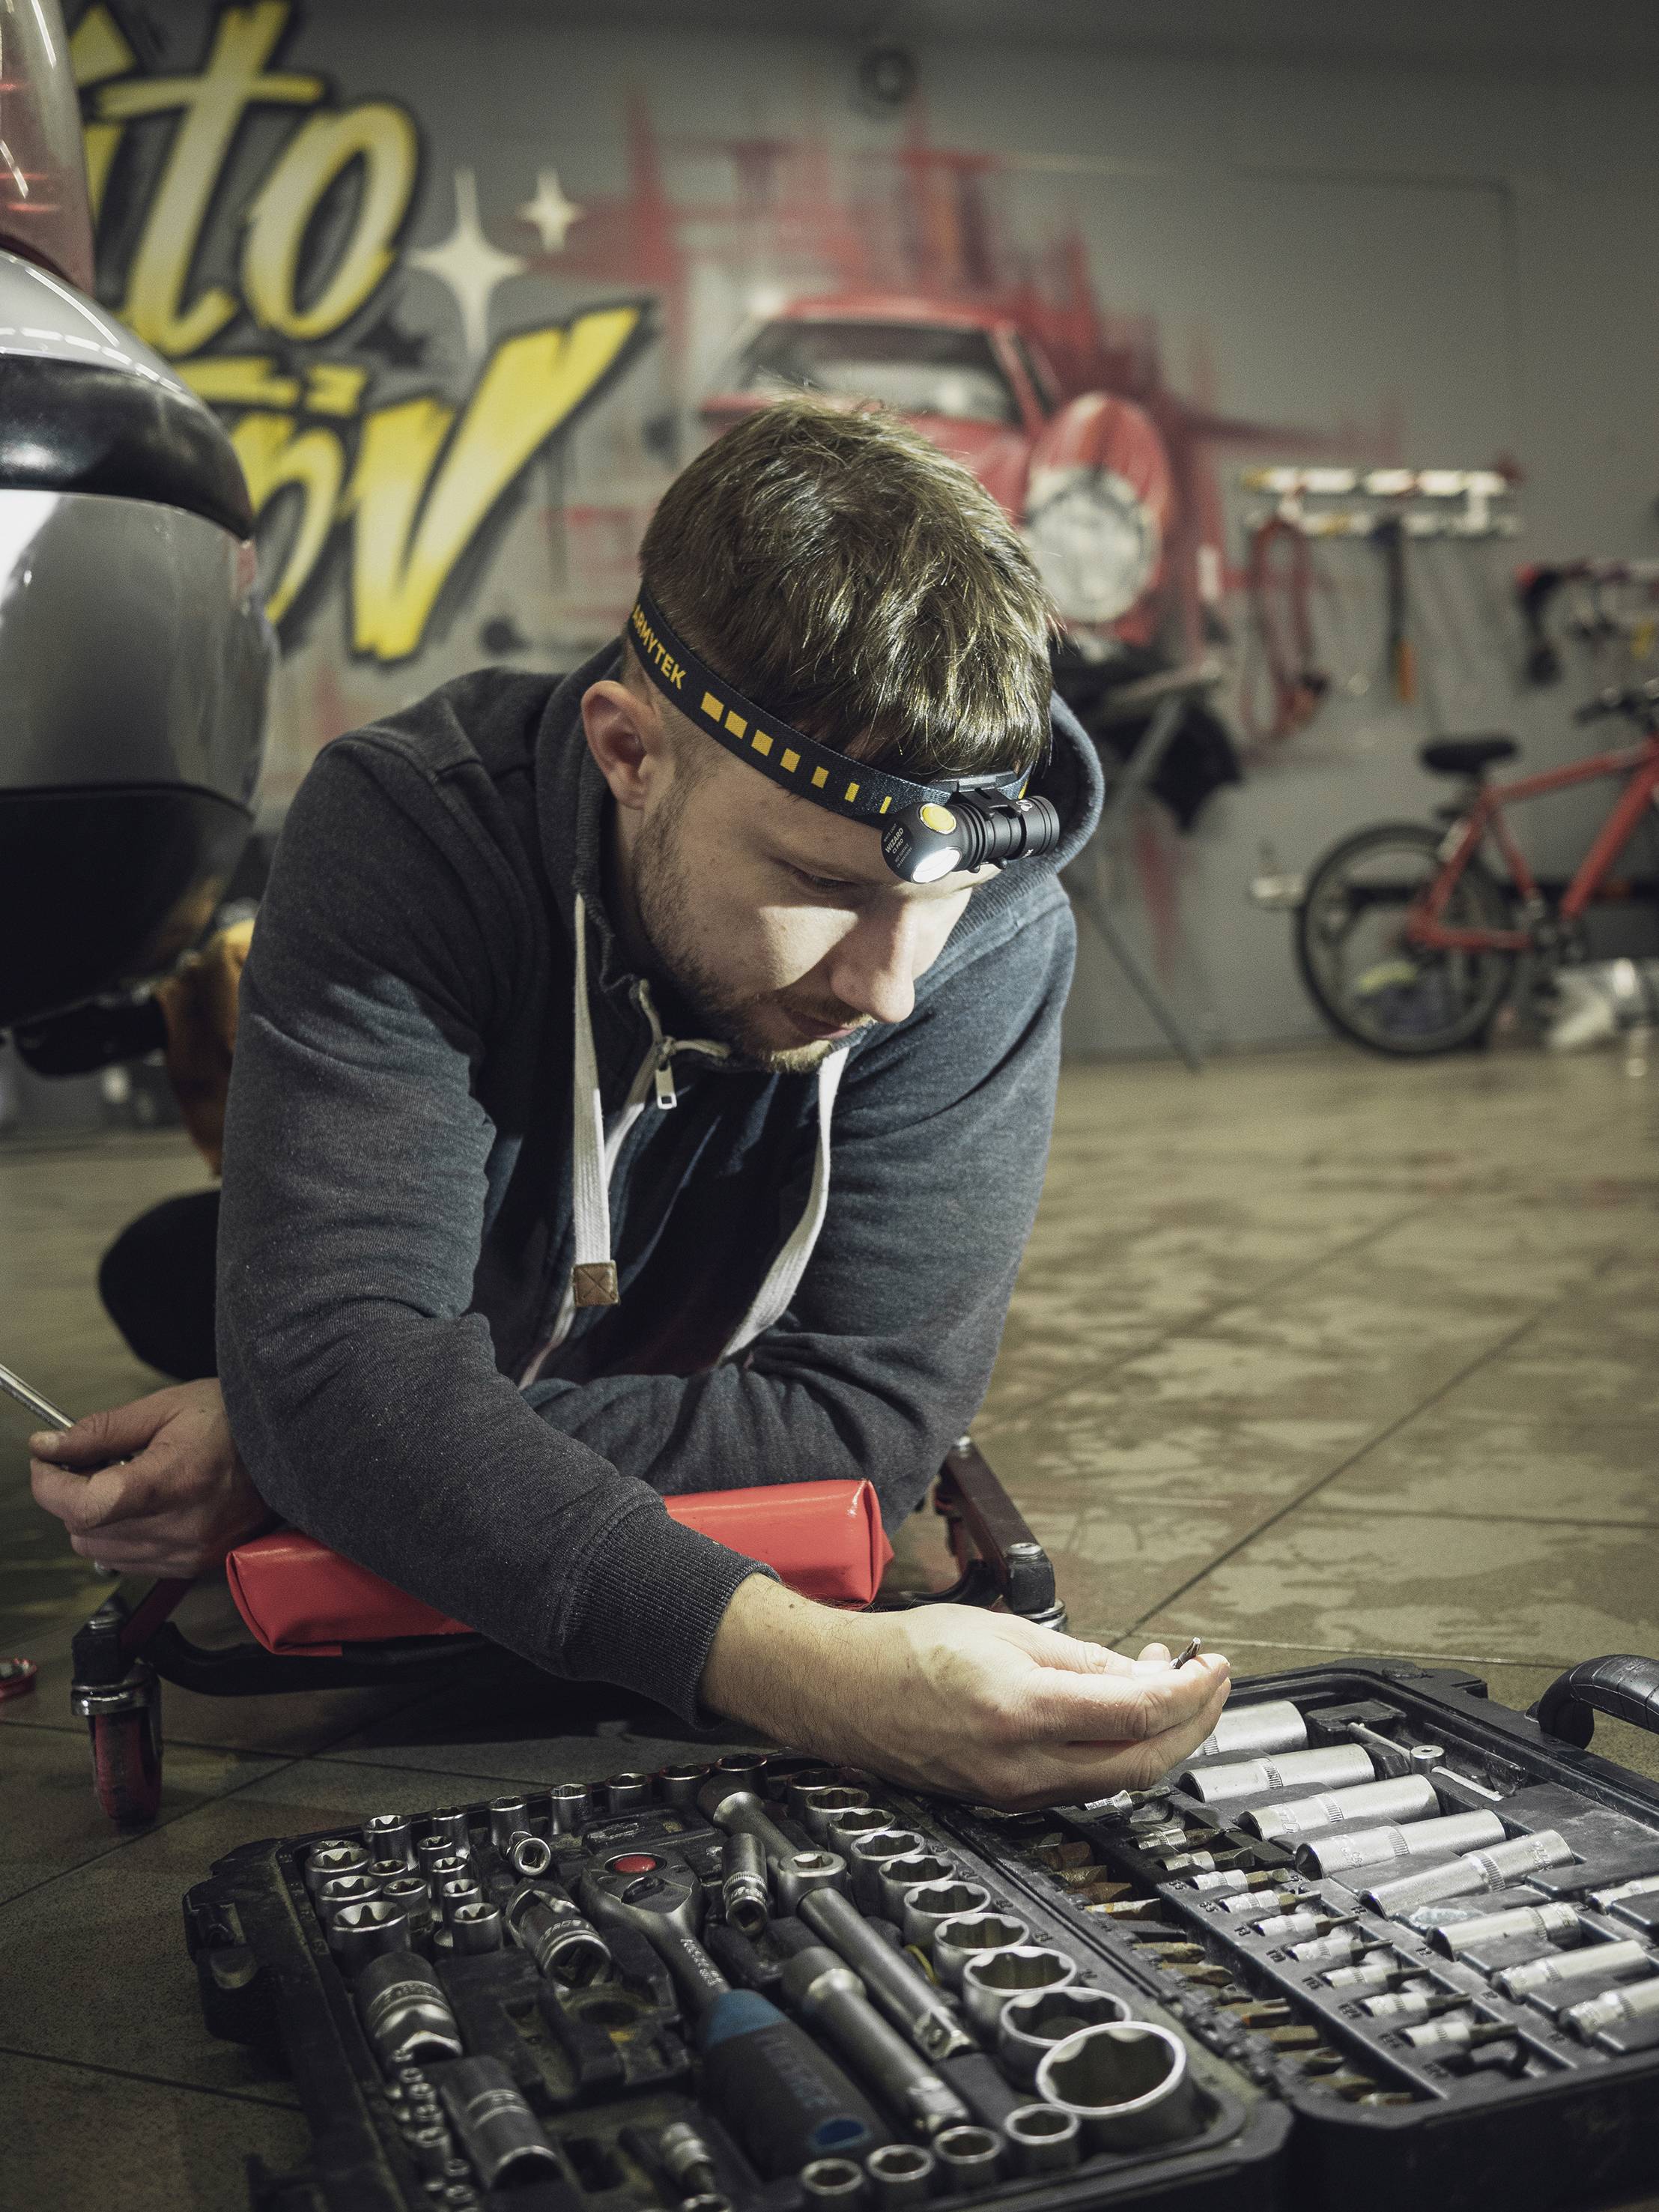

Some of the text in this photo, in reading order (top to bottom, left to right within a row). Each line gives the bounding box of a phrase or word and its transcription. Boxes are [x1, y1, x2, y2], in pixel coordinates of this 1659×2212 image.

[632, 603, 687, 690] ARMYTEK
[885, 827, 905, 853] WIZARD
[896, 838, 904, 849] PRO
